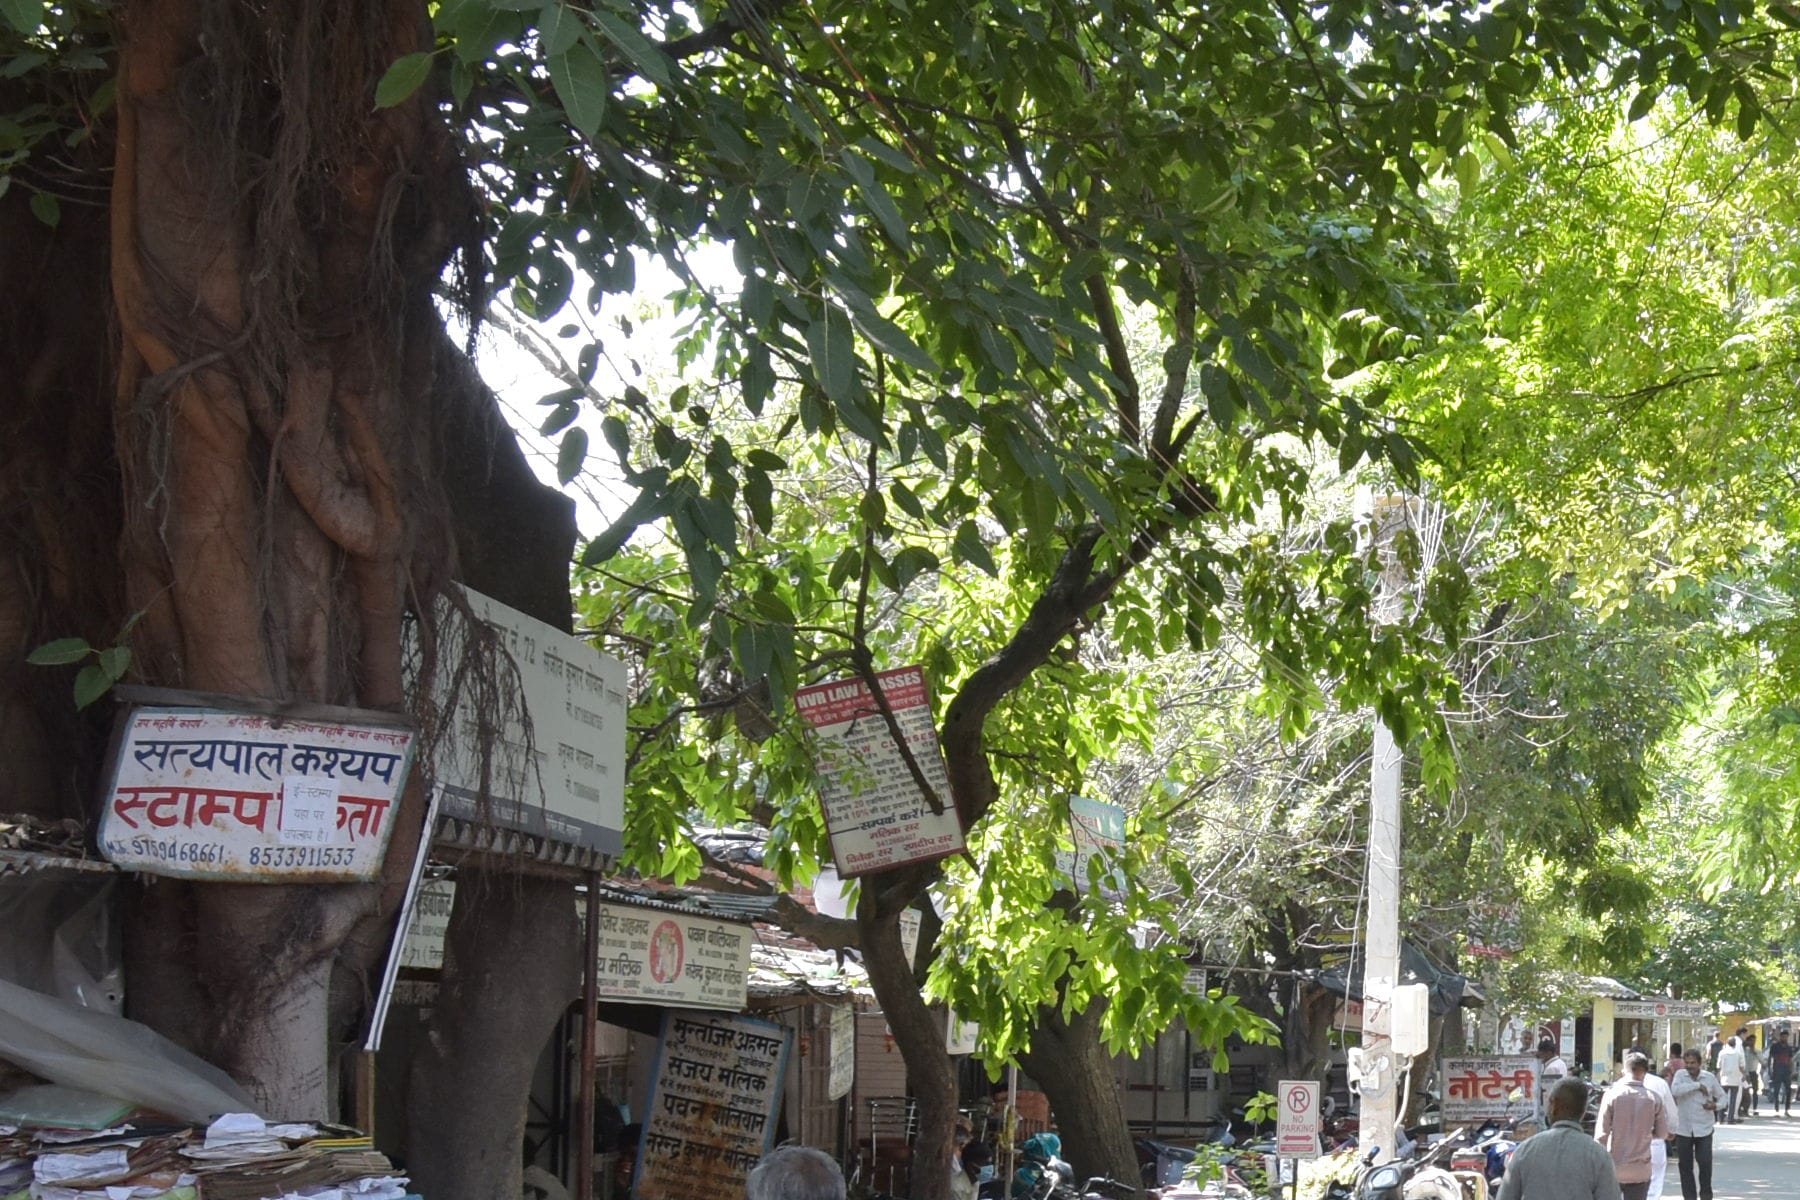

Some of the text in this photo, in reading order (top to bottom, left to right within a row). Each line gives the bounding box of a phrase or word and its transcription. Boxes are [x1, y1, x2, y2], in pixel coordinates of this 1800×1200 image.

[797, 671, 921, 709] NVR LAW CASSES
[134, 740, 289, 780] सत्यपाल
[291, 743, 402, 785] कश्यप
[114, 786, 274, 834] स्टाम्प
[250, 846, 356, 868] 8533911533
[673, 1018, 783, 1057] मुन्तजिर अहमद
[667, 1051, 767, 1091] संजय मलिक
[1281, 1124, 1315, 1133] PARKING
[1292, 1115, 1304, 1123] NO
